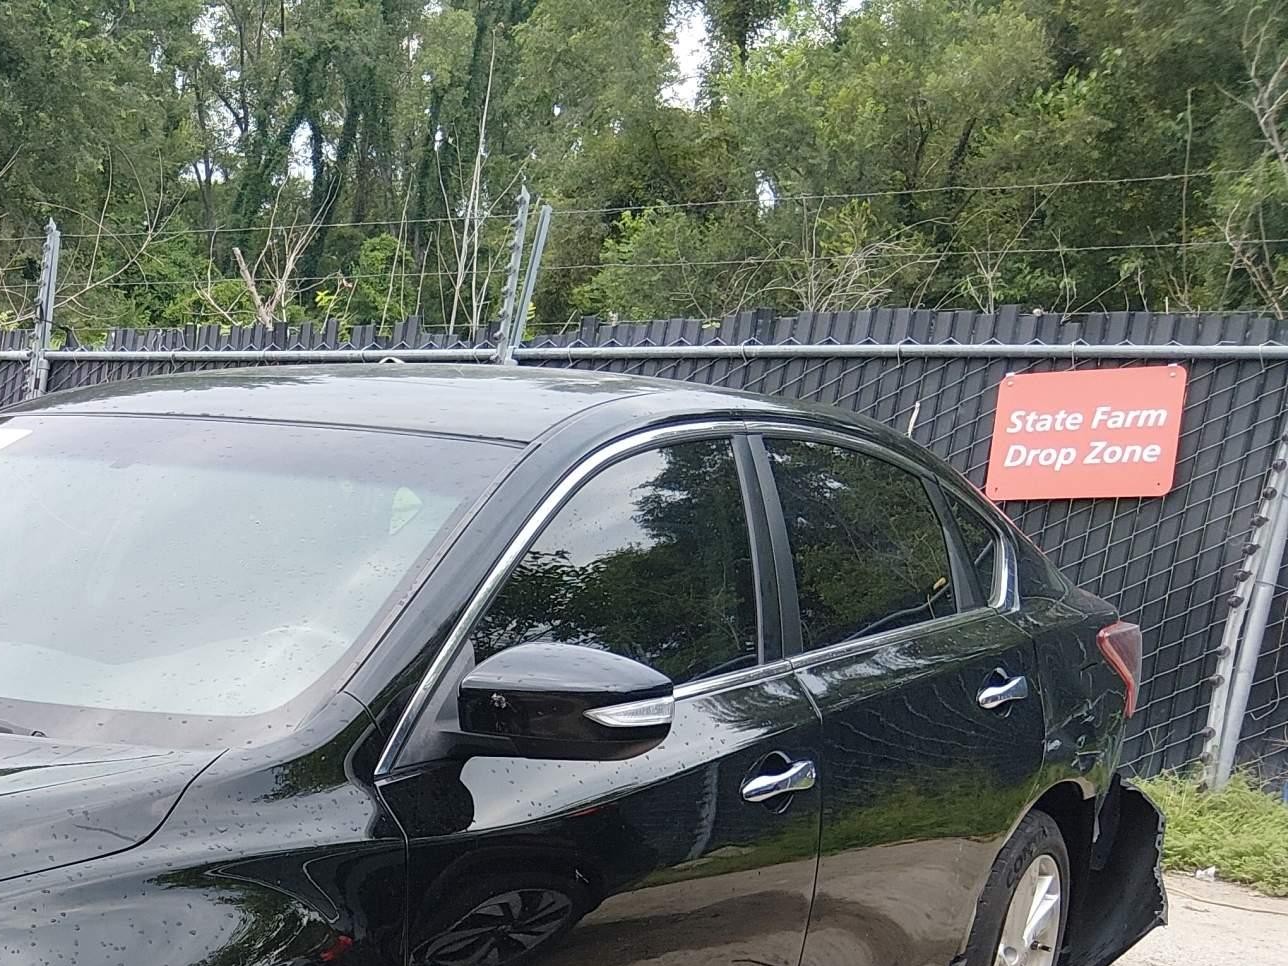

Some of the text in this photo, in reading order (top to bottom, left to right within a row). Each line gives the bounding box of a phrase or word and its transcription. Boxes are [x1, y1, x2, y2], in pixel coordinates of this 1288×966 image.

[1006, 406, 1168, 433] State Farm
[1003, 441, 1162, 471] Drop Zone
